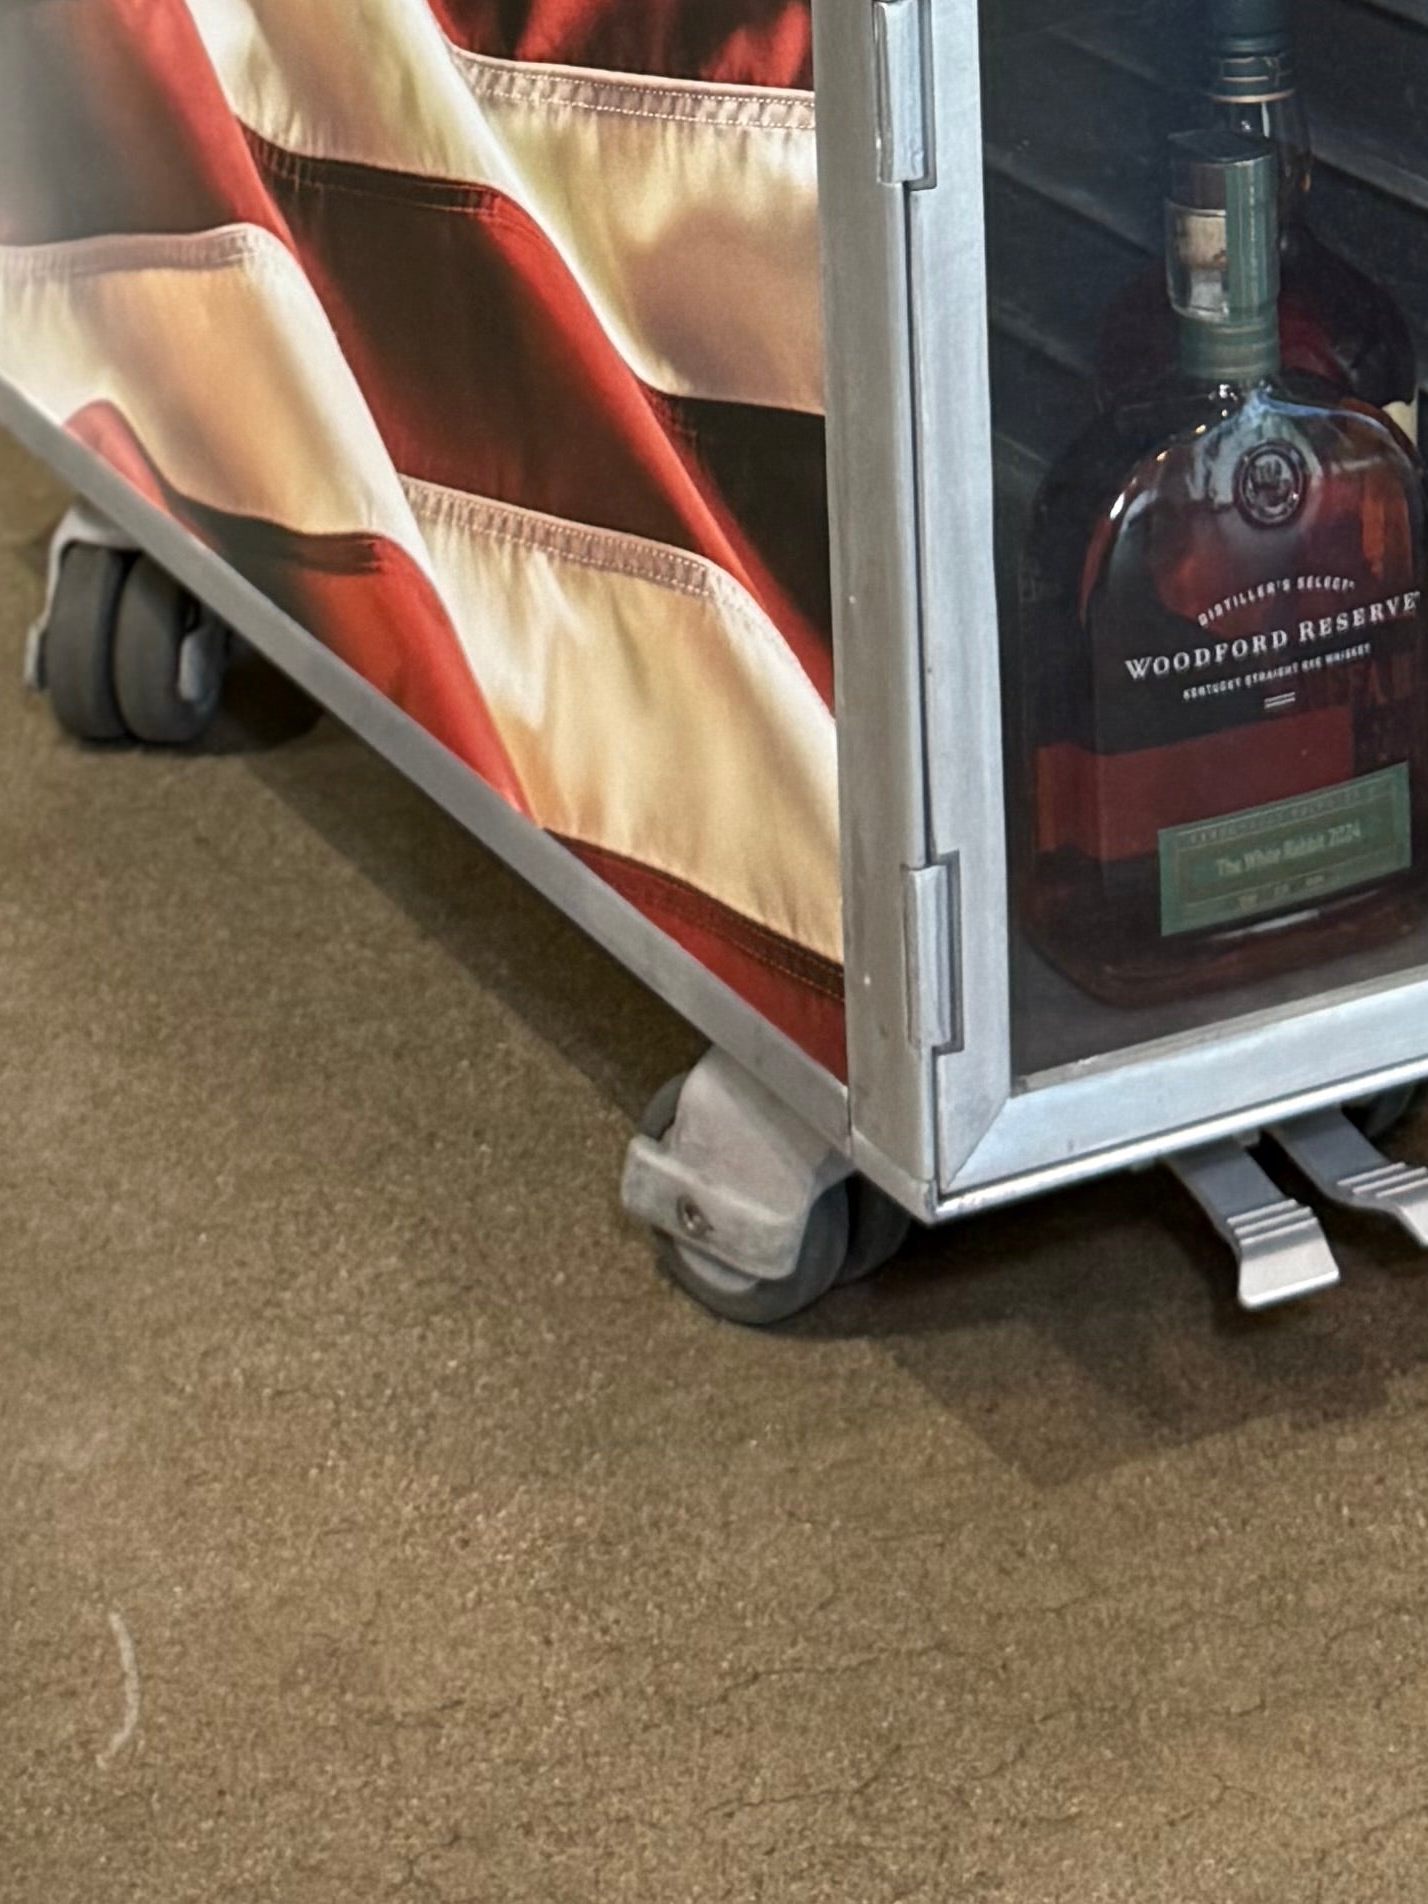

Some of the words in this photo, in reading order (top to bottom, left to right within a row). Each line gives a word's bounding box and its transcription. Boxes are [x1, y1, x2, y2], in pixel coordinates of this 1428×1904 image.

[1197, 578, 1291, 628] DISTILLER'S
[1124, 629, 1288, 681] WOODFORD
[1298, 591, 1420, 643] RESERVE
[1182, 676, 1242, 701] KENTUCKY
[1245, 661, 1299, 688] STRAIGHT
[1324, 642, 1371, 664] WHISKEY
